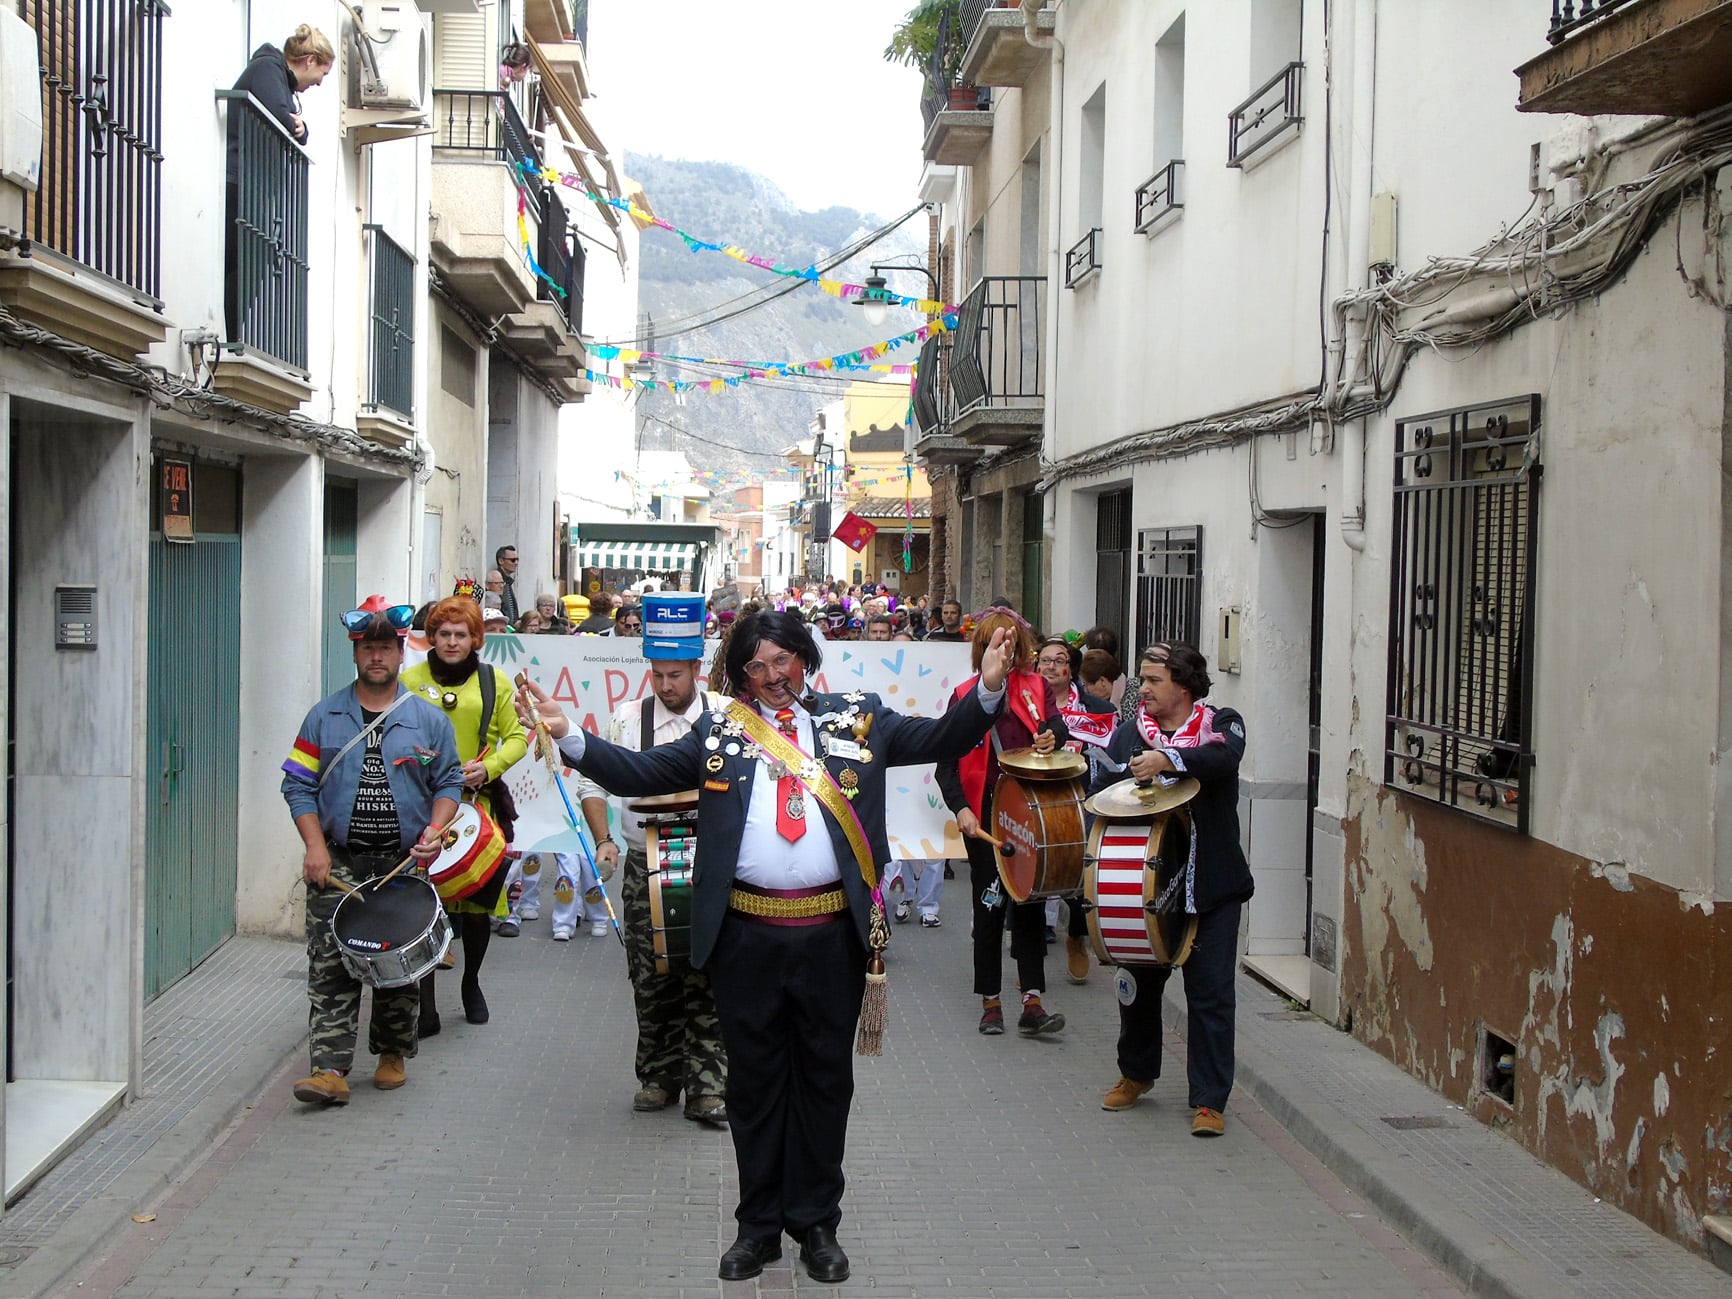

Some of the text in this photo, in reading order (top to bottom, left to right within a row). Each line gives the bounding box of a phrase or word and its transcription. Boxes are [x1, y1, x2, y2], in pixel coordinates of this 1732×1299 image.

[583, 655, 619, 663] Asociación
[621, 655, 644, 664] Lojeña
[347, 938, 381, 950] COMANDO
